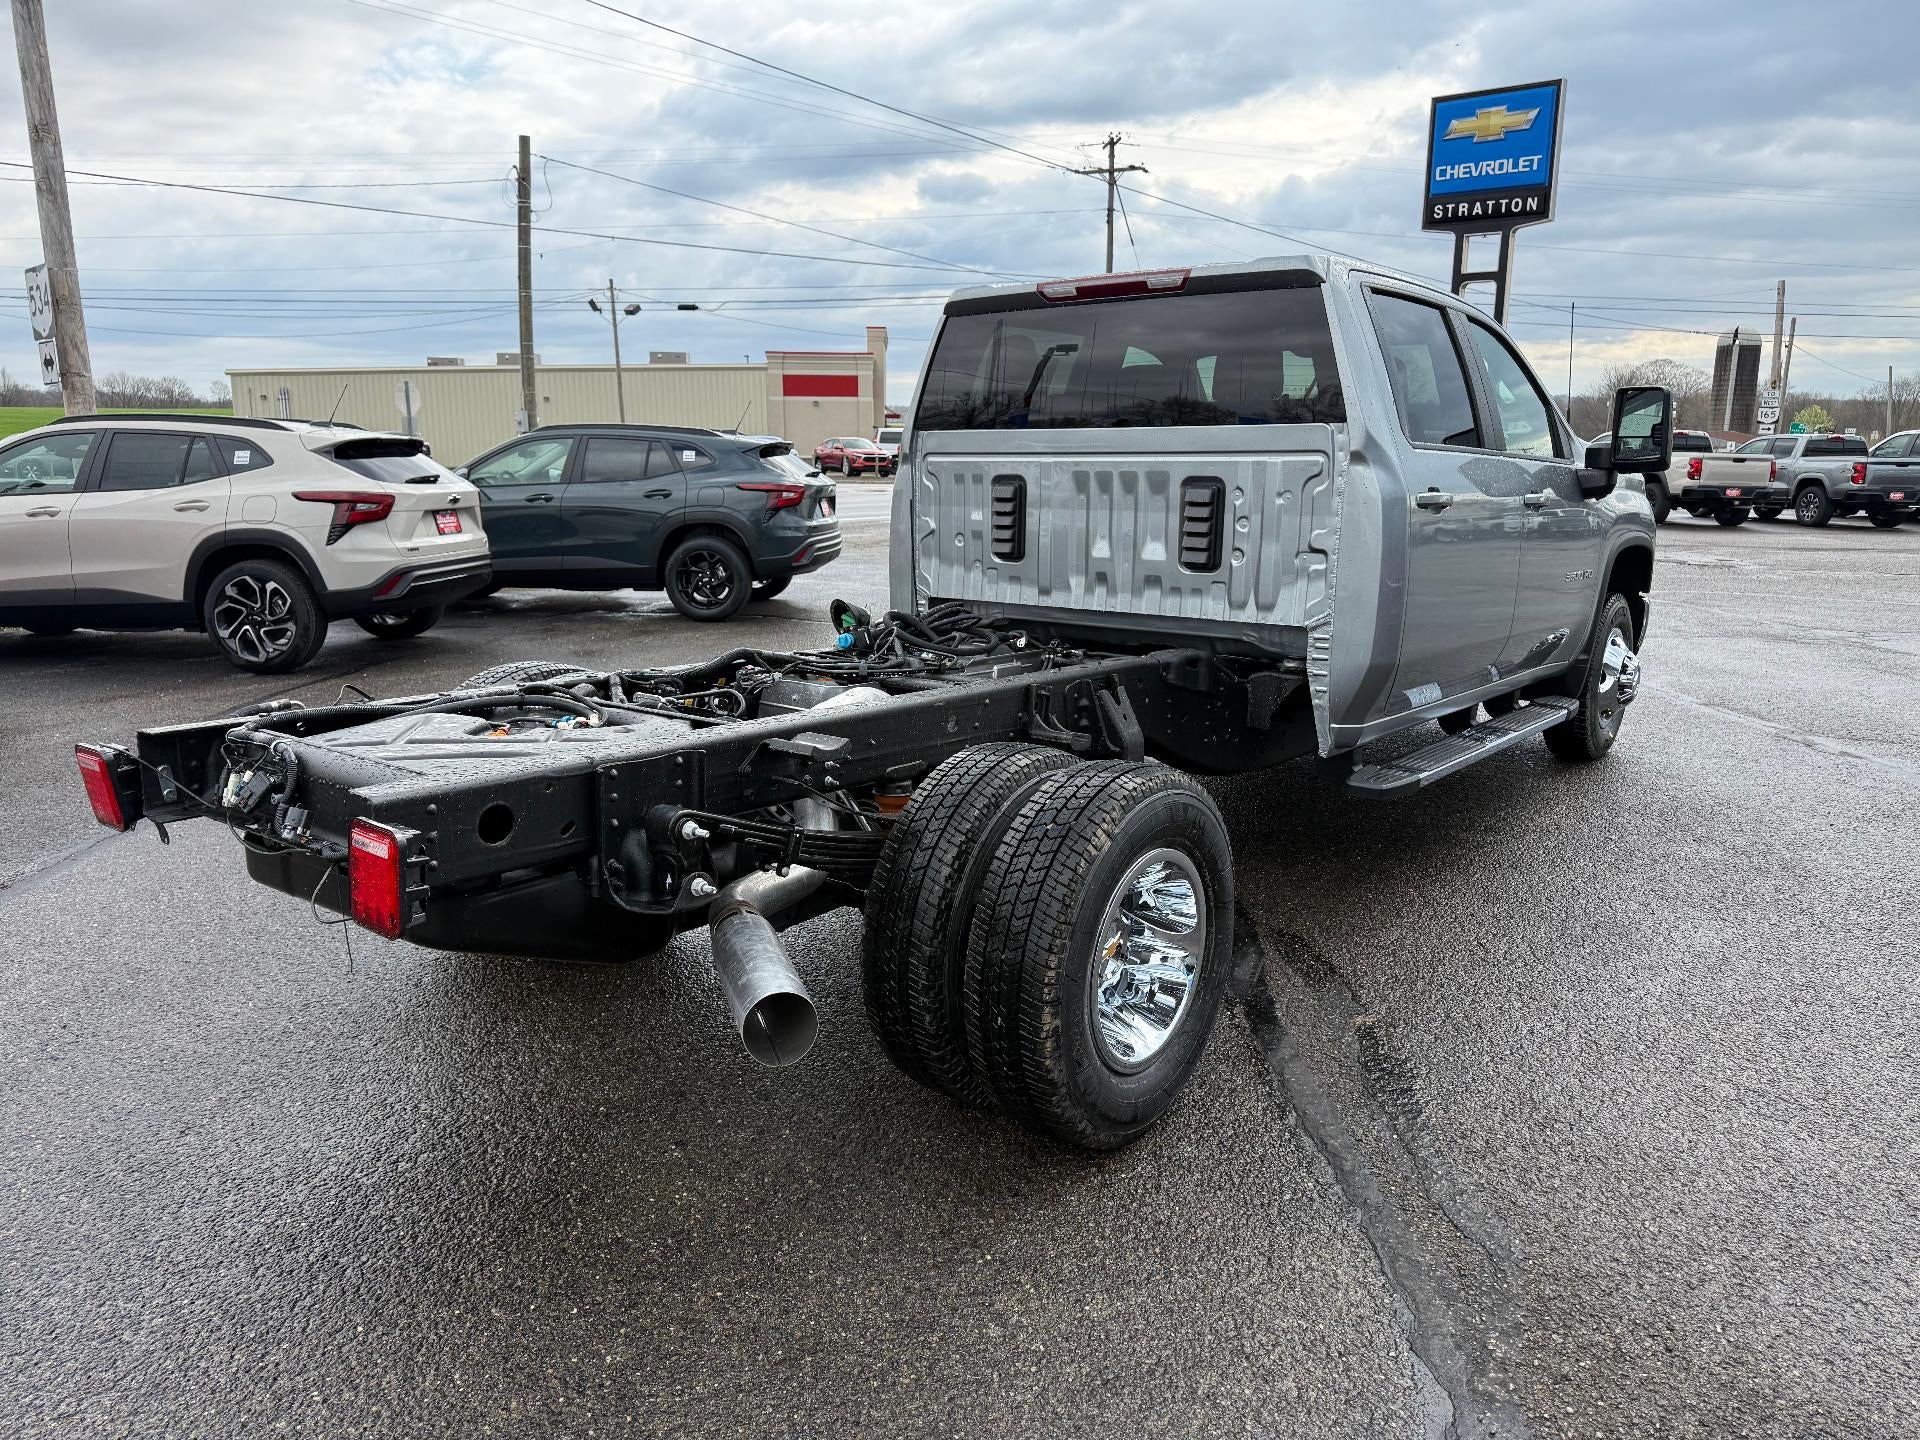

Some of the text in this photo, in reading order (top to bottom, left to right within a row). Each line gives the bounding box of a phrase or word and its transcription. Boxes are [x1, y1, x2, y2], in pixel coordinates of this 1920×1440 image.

[1435, 155, 1542, 181] CHEVROLET
[1433, 197, 1538, 218] STRATTON
[29, 281, 51, 317] 534
[1760, 410, 1777, 419] 165
